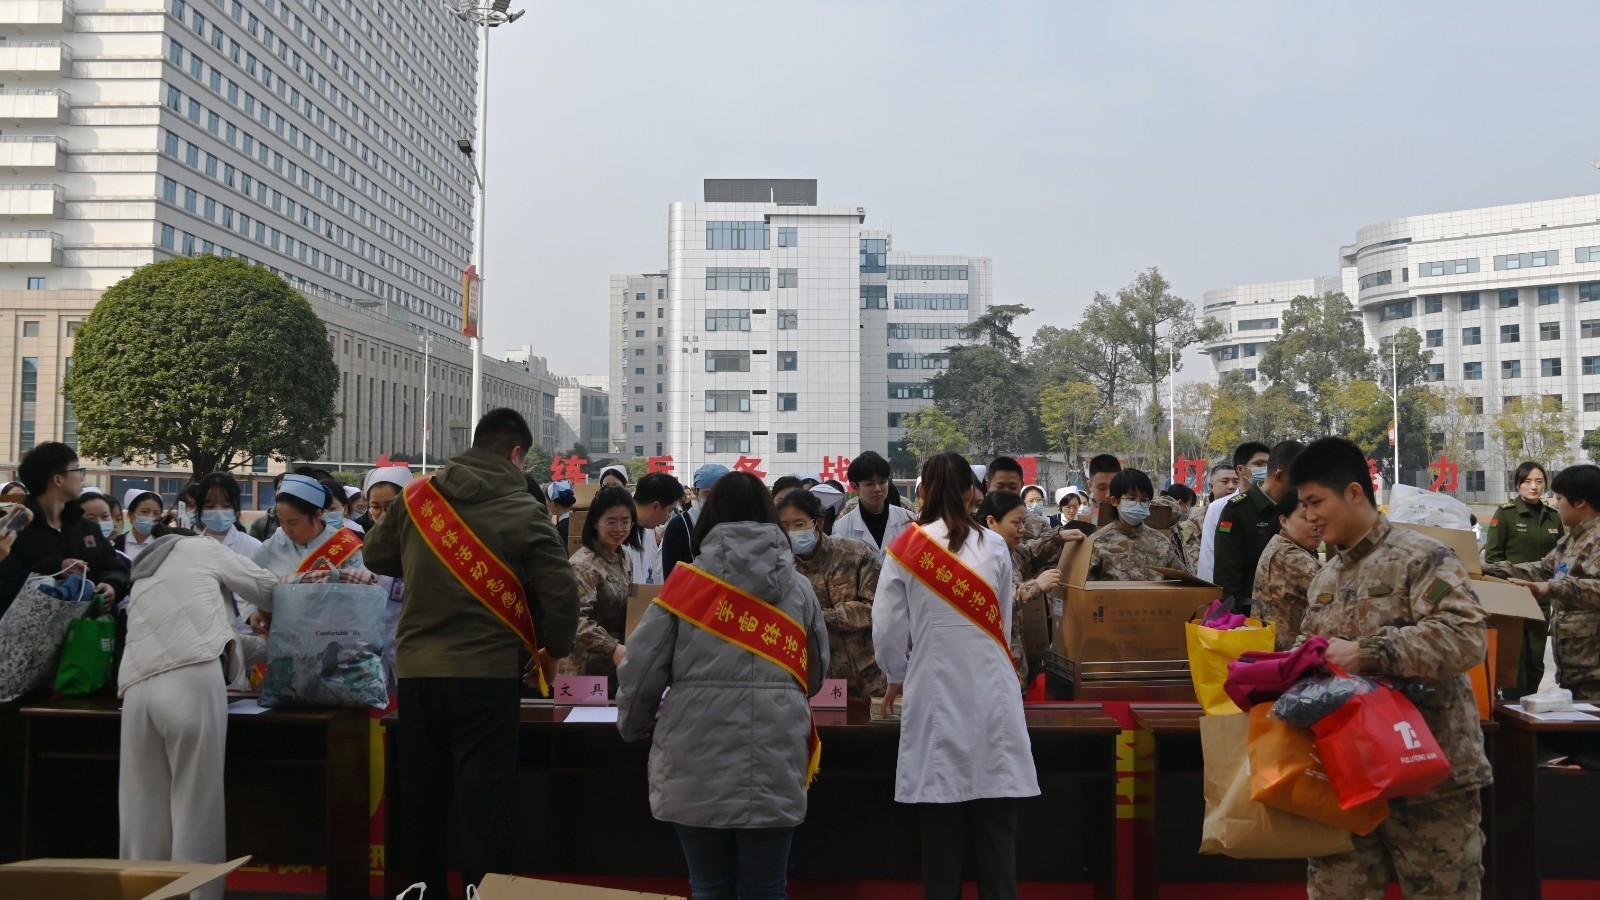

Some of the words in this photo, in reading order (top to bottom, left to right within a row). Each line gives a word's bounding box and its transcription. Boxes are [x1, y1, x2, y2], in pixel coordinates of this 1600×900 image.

[319, 533, 357, 569] 学雷
[420, 499, 525, 618] 学雷锋活动志愿者
